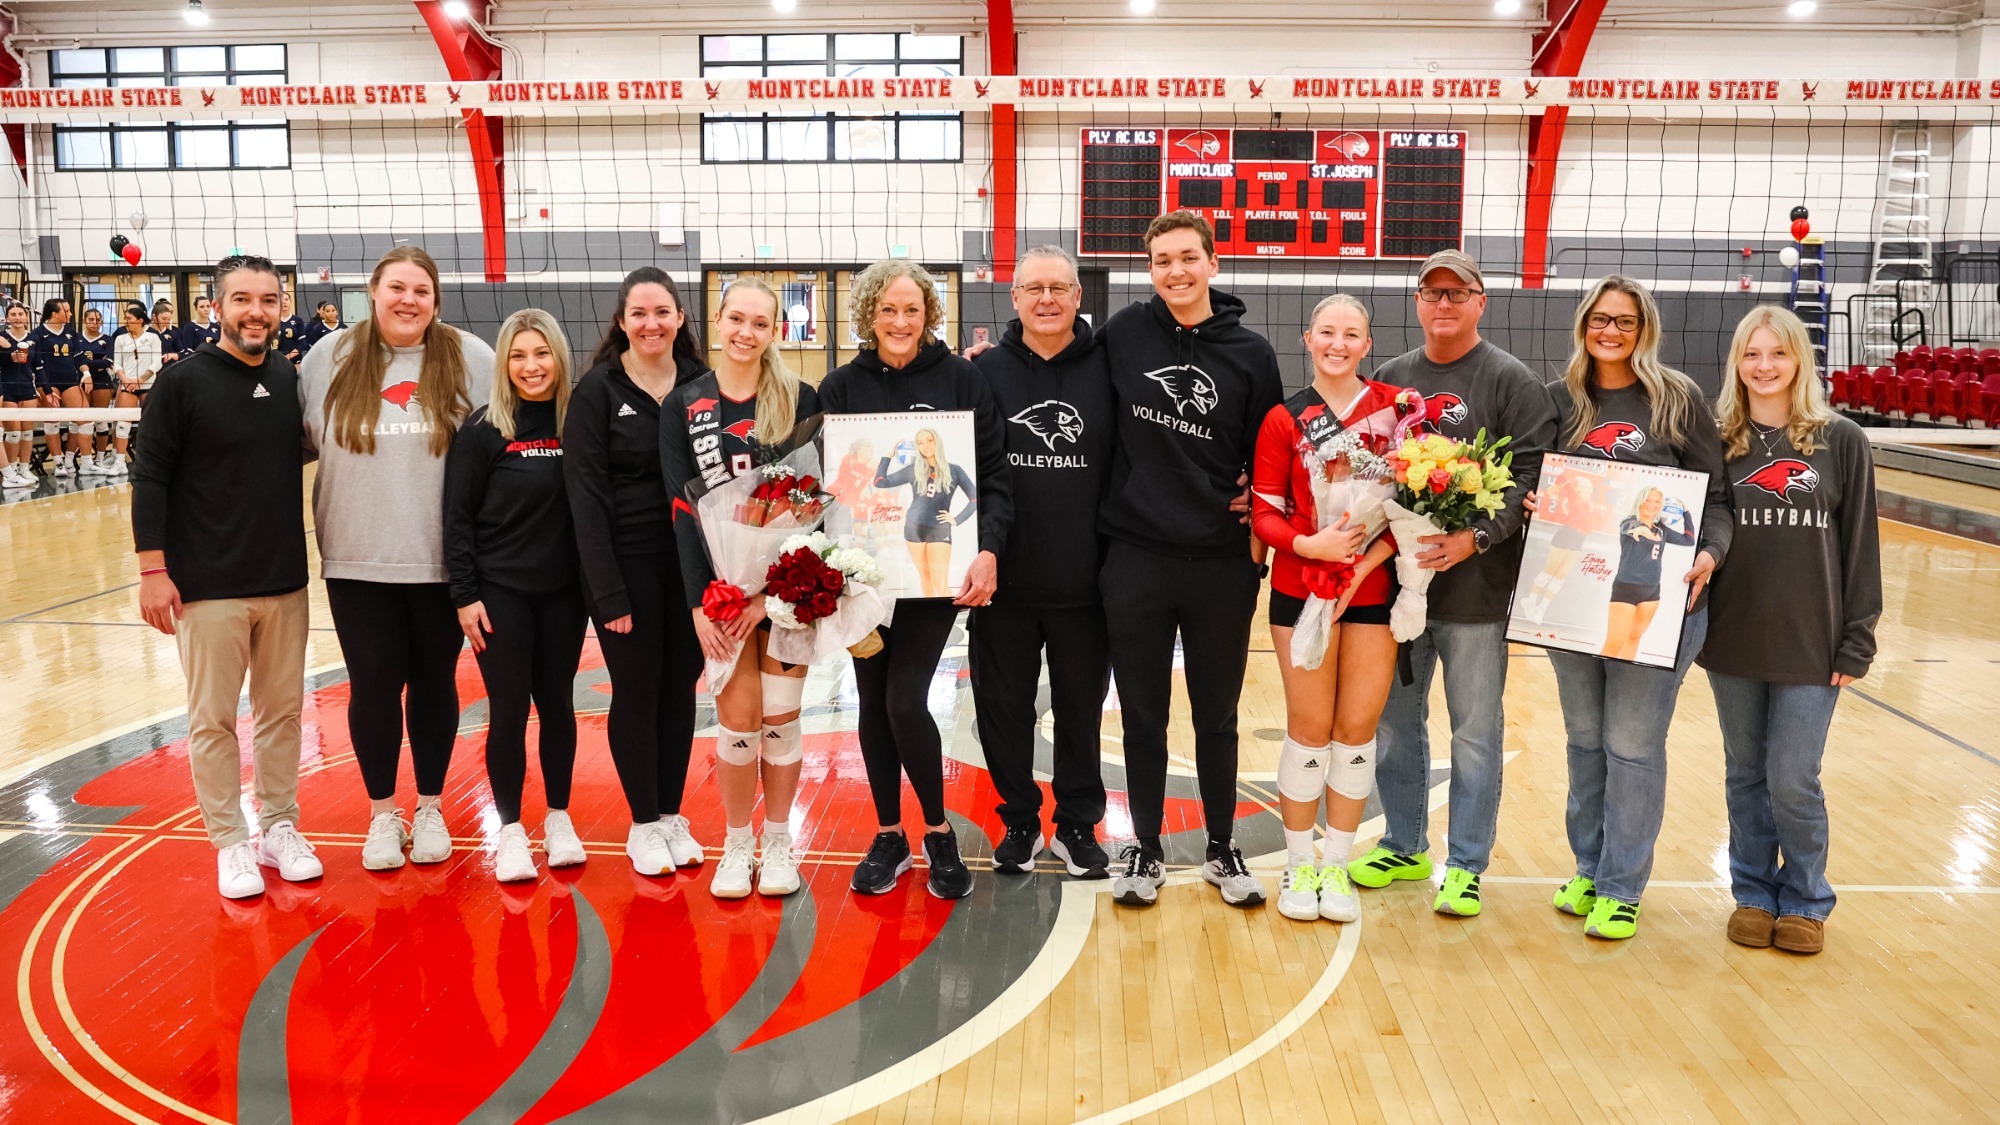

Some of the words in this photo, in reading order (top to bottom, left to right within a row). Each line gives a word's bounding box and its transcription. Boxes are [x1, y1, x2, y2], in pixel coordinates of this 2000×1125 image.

[487, 81, 609, 102] MONTCLAIR
[617, 80, 684, 101] STATE
[747, 79, 874, 99] MONTCLAIR
[883, 78, 952, 99] STATE
[1018, 78, 1148, 98] MONTCLAIR
[1156, 78, 1226, 98] STATE
[1292, 78, 1424, 98] MONTCLAIR
[1431, 78, 1502, 98] STATE
[1567, 79, 1700, 100] MONTCLAIR
[1708, 80, 1780, 100] STATE
[1846, 80, 1981, 100] MONTCLAIR
[0, 89, 114, 108] MONTCLAIR
[121, 87, 182, 107] STATE
[240, 86, 357, 107] MONTCLAIR
[364, 84, 428, 105] STATE
[1088, 130, 1111, 144] PLY
[1115, 131, 1131, 144] AC
[1134, 131, 1157, 144] KLS
[1390, 133, 1413, 147] PLY
[1417, 133, 1433, 147] AC
[1436, 133, 1459, 147] KLS
[1169, 164, 1234, 178] MONTCLAIR
[1257, 171, 1288, 181] PERIOD
[1311, 165, 1374, 179] ST.JOSEPH
[1212, 209, 1235, 219] T.O.L.
[1244, 210, 1276, 220] PLAYER
[1278, 210, 1300, 220] FOUL
[1309, 210, 1331, 221] T.O.L.
[1340, 211, 1368, 221] FOULS
[1256, 245, 1285, 255] MATCH
[1339, 246, 1367, 256] SCORE
[53, 343, 70, 357] 14
[695, 411, 712, 423] #9
[1132, 404, 1213, 440] VOLLEYBALL
[1312, 415, 1328, 431] #6
[1734, 507, 1829, 529] LLEYBALL
